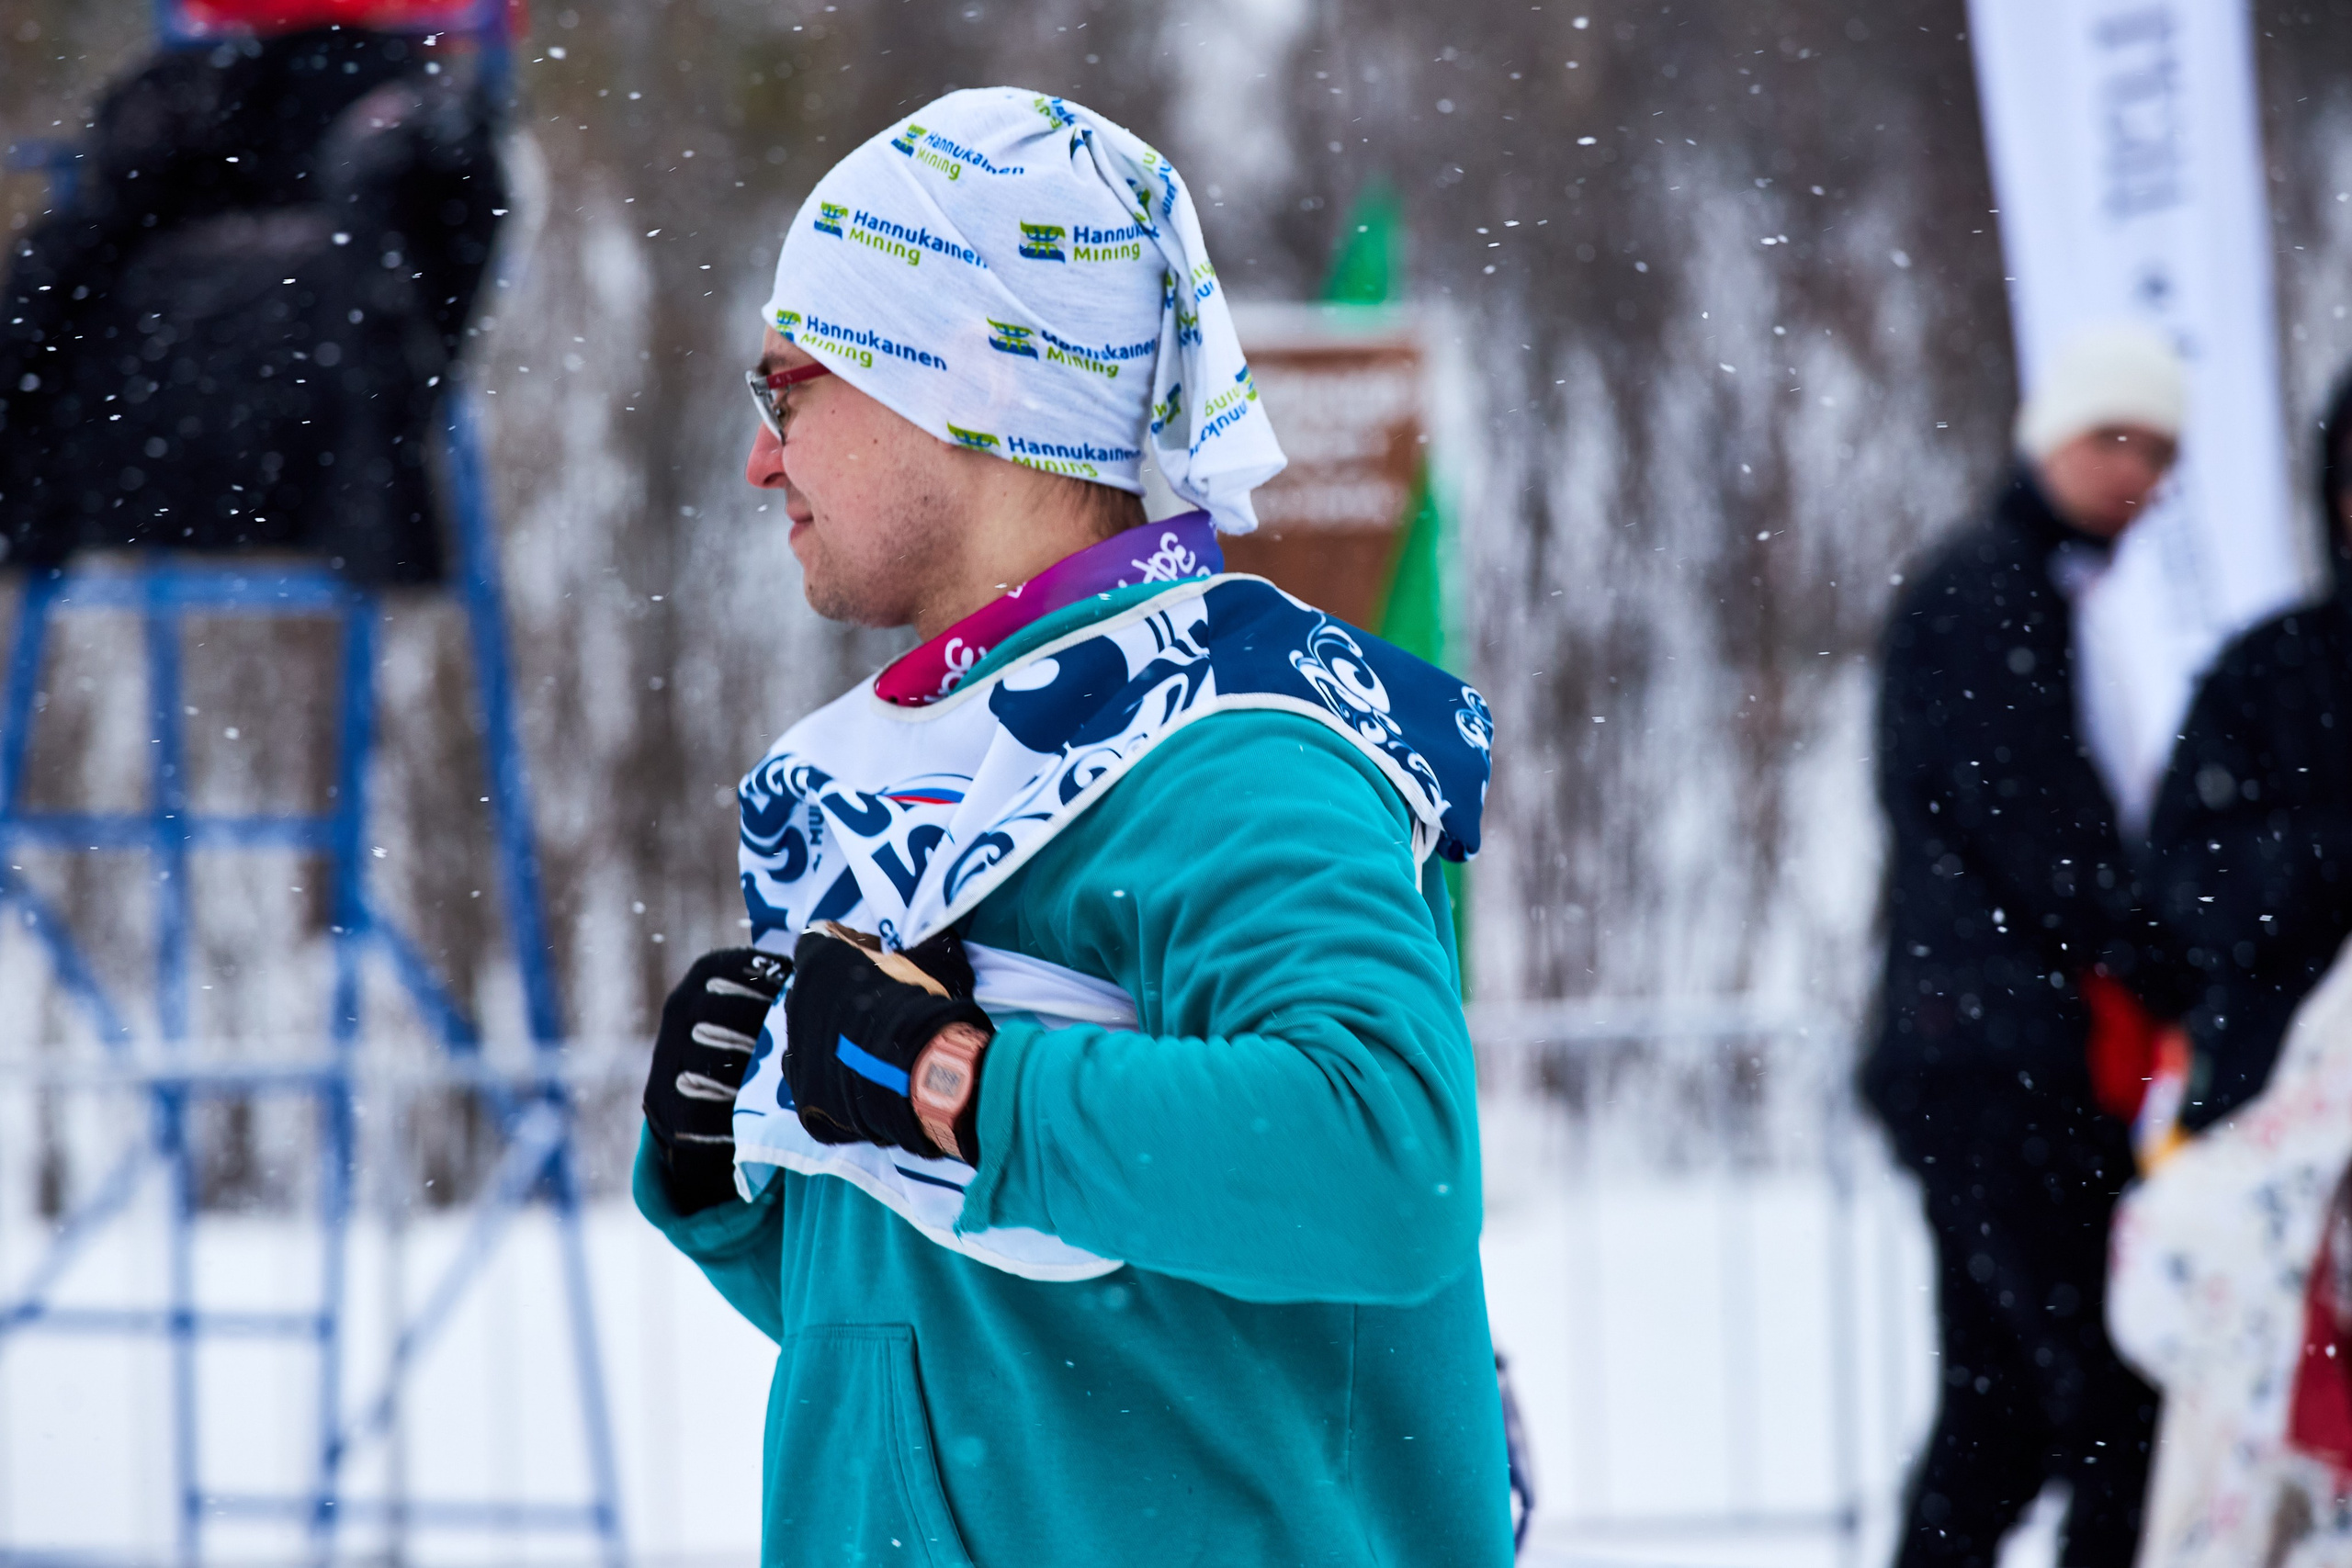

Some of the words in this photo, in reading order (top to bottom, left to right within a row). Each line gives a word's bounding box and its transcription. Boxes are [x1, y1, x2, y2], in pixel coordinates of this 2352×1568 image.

[848, 226, 921, 266] Mining
[1073, 243, 1140, 261] Mining
[800, 333, 873, 369] Mining
[807, 315, 947, 371] Hannukainen
[1046, 345, 1119, 378] Mining
